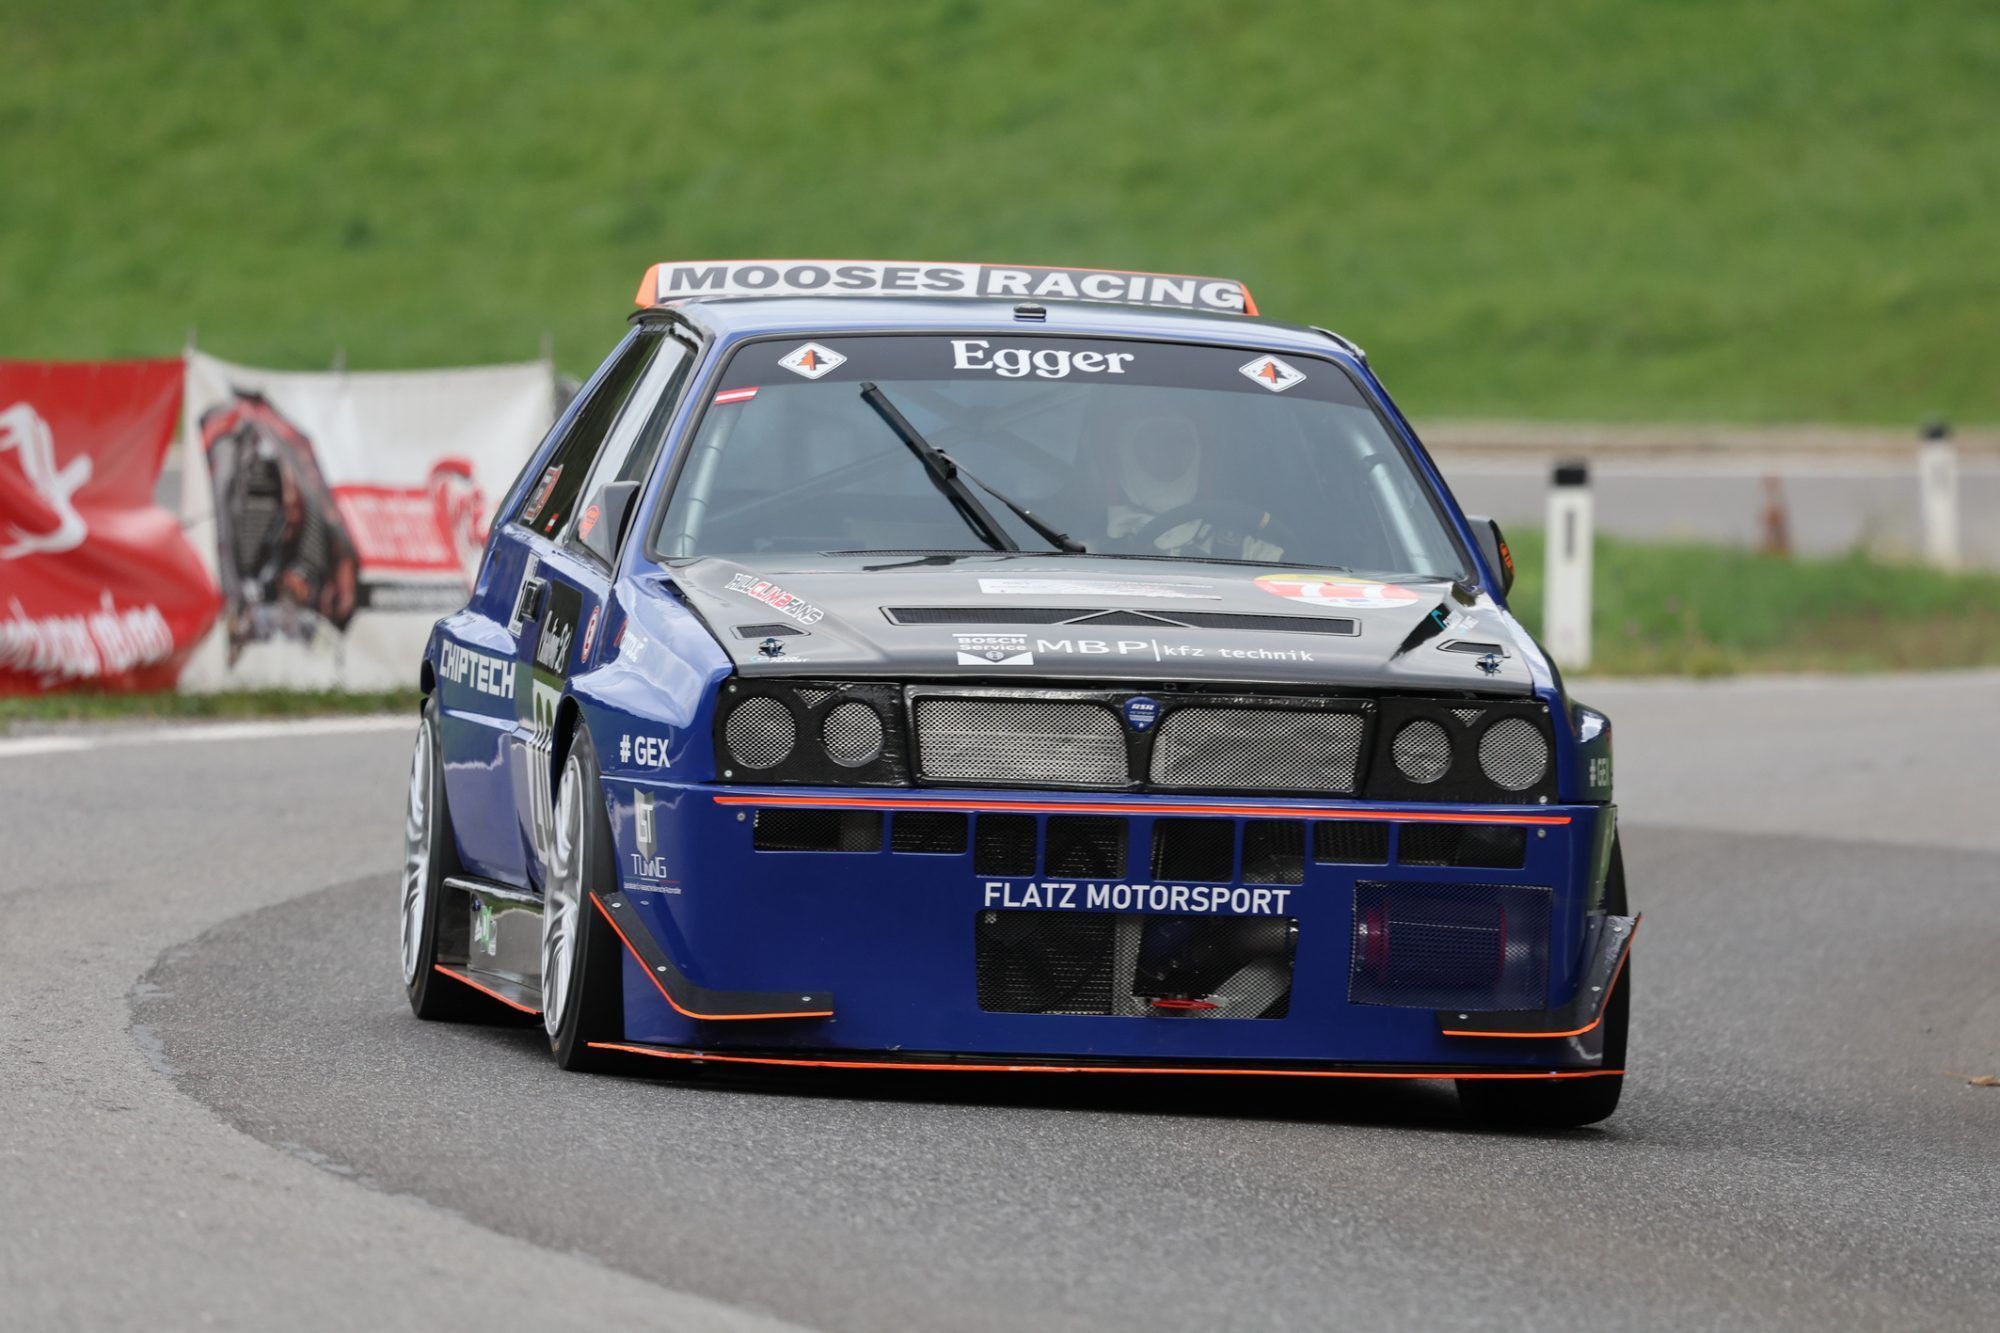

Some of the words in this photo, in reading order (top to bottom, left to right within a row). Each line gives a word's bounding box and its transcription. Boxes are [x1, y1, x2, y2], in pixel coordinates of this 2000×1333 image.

[669, 265, 965, 292] MOOSES
[986, 269, 1246, 310] RACING
[950, 340, 1135, 379] Egger
[439, 639, 516, 699] CHIPTECH
[1036, 639, 1149, 655] MBP
[1163, 644, 1205, 657] kfz
[1218, 648, 1315, 662] technik
[983, 882, 1077, 909] FLATZ
[1087, 884, 1291, 915] MOTORSPORT
